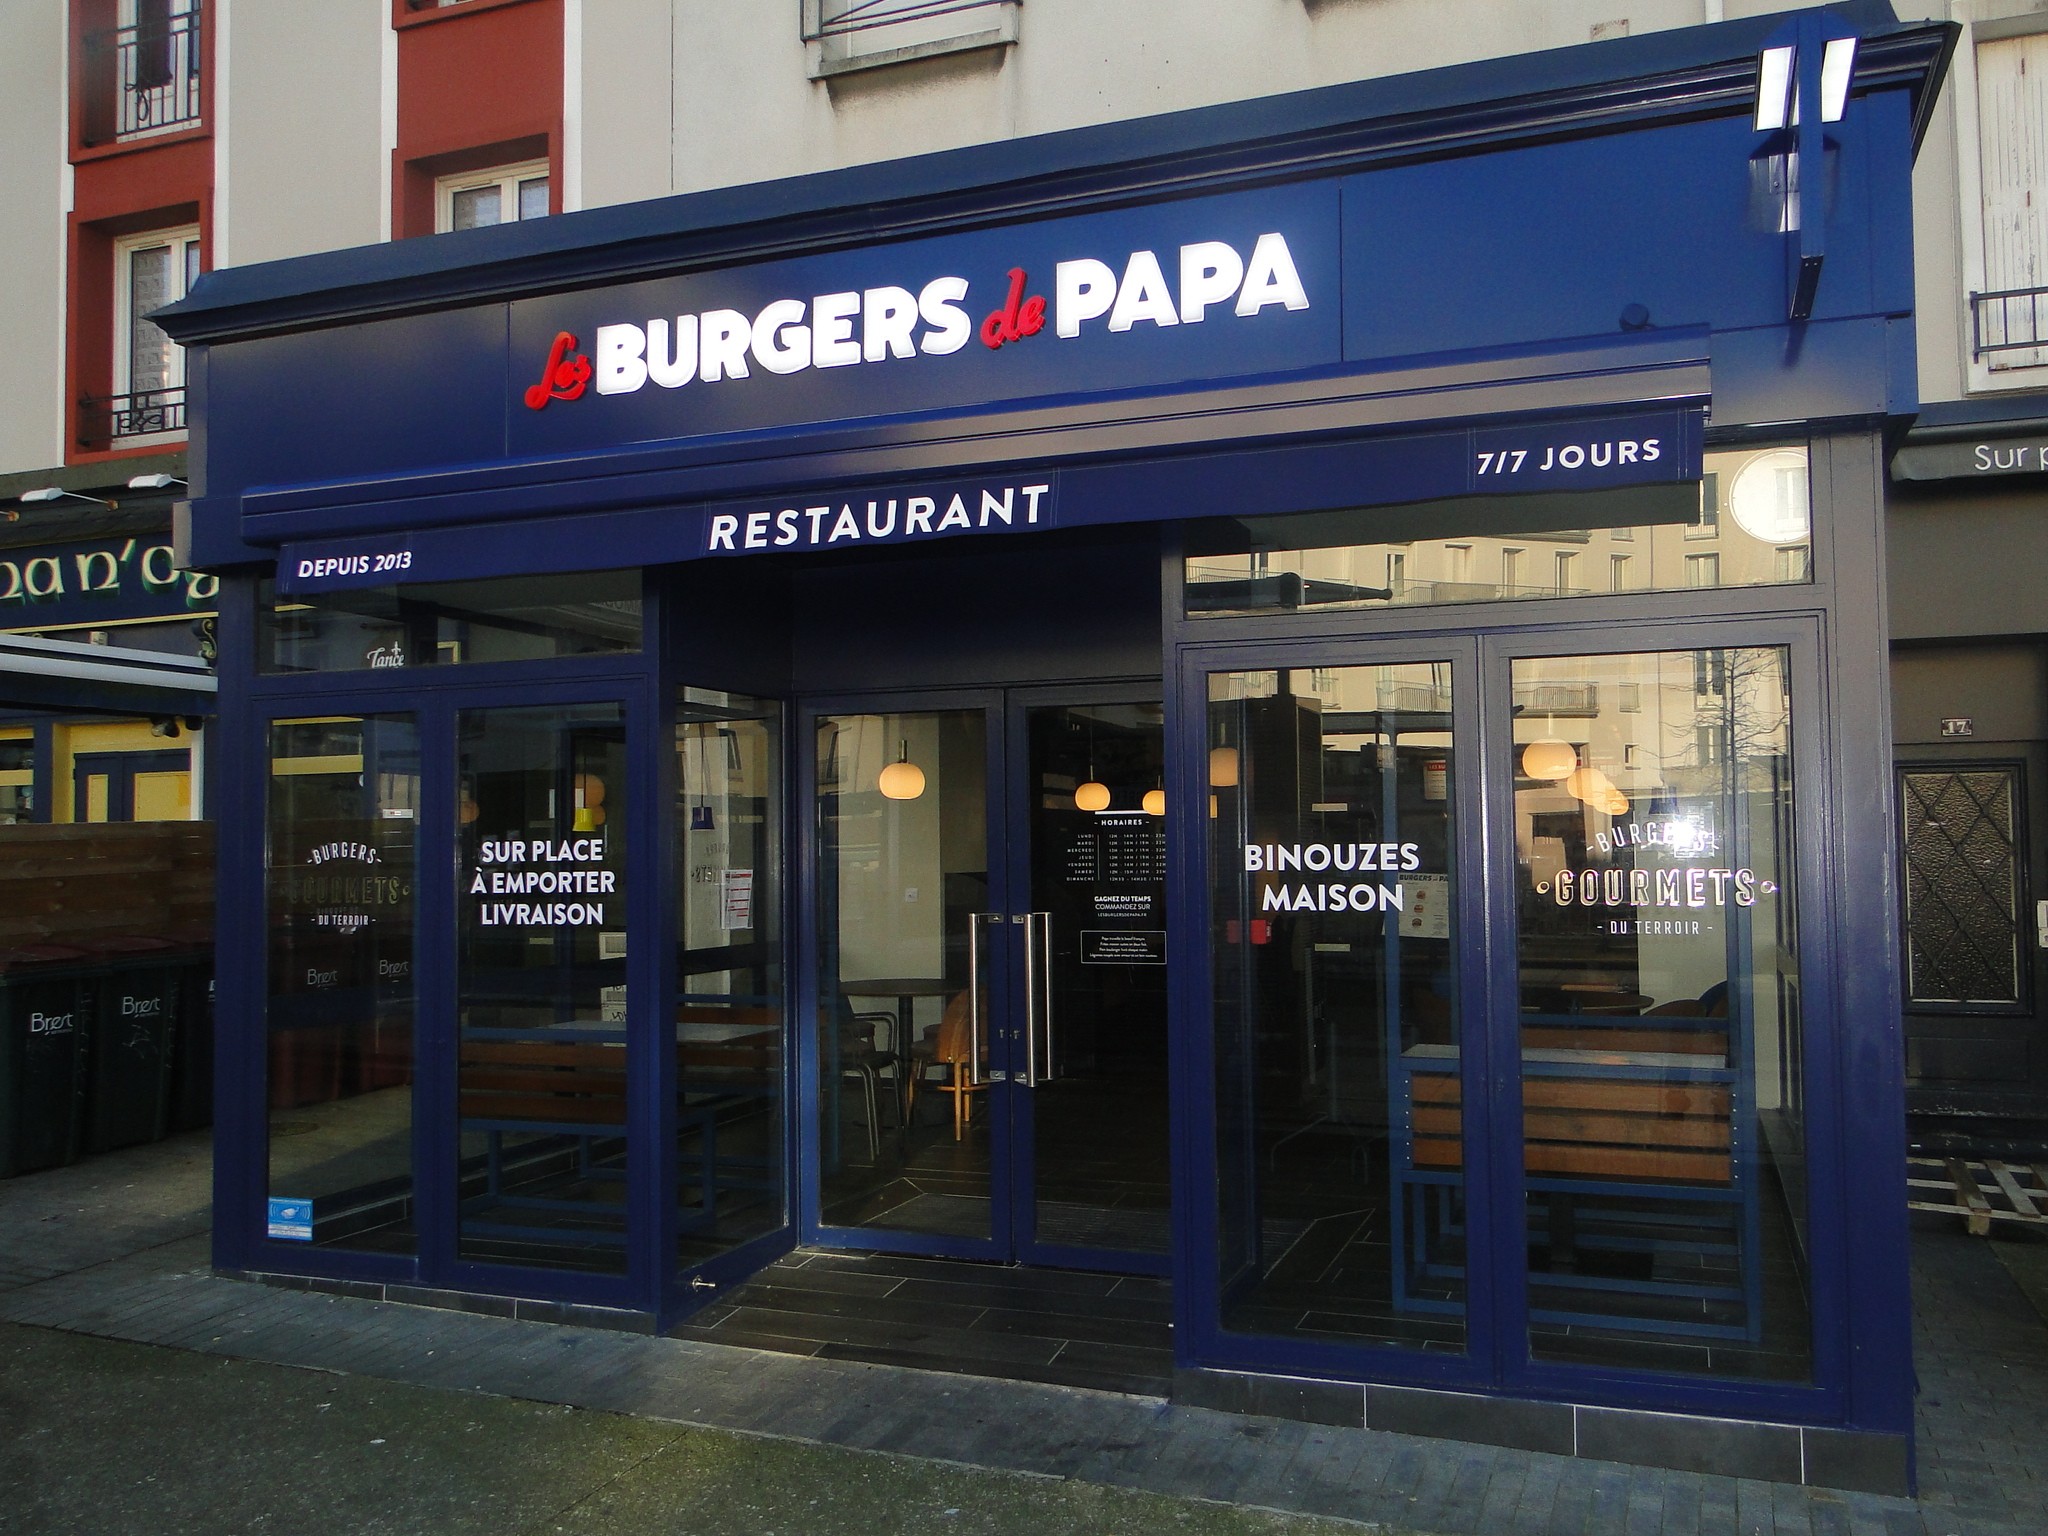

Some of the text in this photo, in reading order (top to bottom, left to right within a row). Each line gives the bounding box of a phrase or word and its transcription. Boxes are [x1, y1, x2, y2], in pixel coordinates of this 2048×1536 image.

[524, 232, 1310, 411] Les BURGERS de PAPA
[1477, 439, 1660, 475] 7/7 JOURS
[1974, 445, 2029, 471] Sur
[708, 484, 1049, 551] RESTAURANT
[298, 551, 412, 578] DEPUIS 2013
[1948, 721, 1967, 733] 17
[482, 839, 604, 862] SUR PLACE
[1245, 843, 1420, 871] BINOUZES
[470, 866, 615, 893] À EMPORTER
[1555, 868, 1756, 907] GOURMETS
[1262, 884, 1403, 911] MAISON
[318, 915, 369, 926] DU TERROIR
[481, 903, 604, 925] LIVRAISON
[1610, 921, 1700, 935] DU TERROIR
